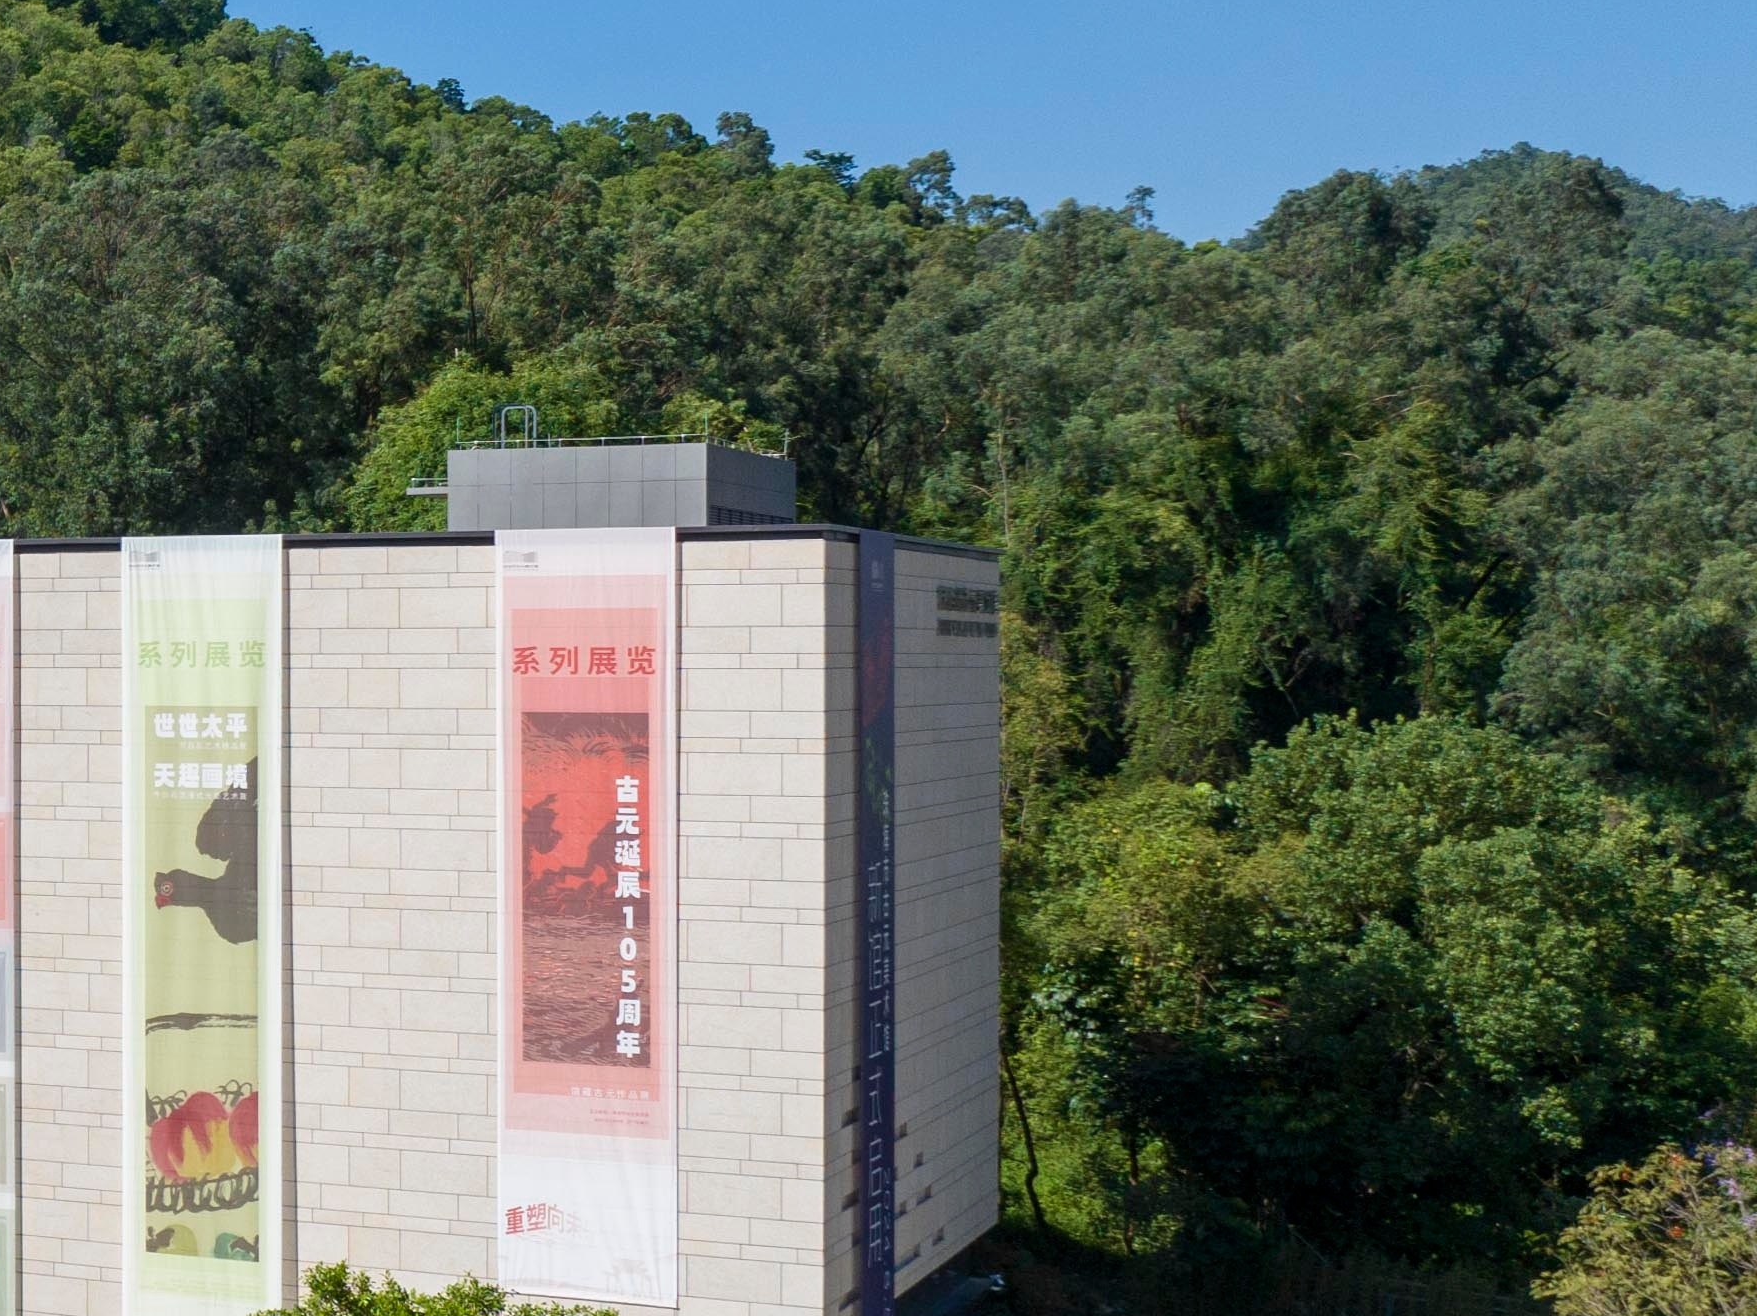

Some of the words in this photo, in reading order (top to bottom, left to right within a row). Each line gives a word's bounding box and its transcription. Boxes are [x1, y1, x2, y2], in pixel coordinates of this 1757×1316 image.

[138, 640, 266, 668] 系列展览
[512, 645, 656, 675] 系列展览
[153, 712, 248, 739] 世世太平
[614, 775, 641, 1059] 古元诞辰105周年
